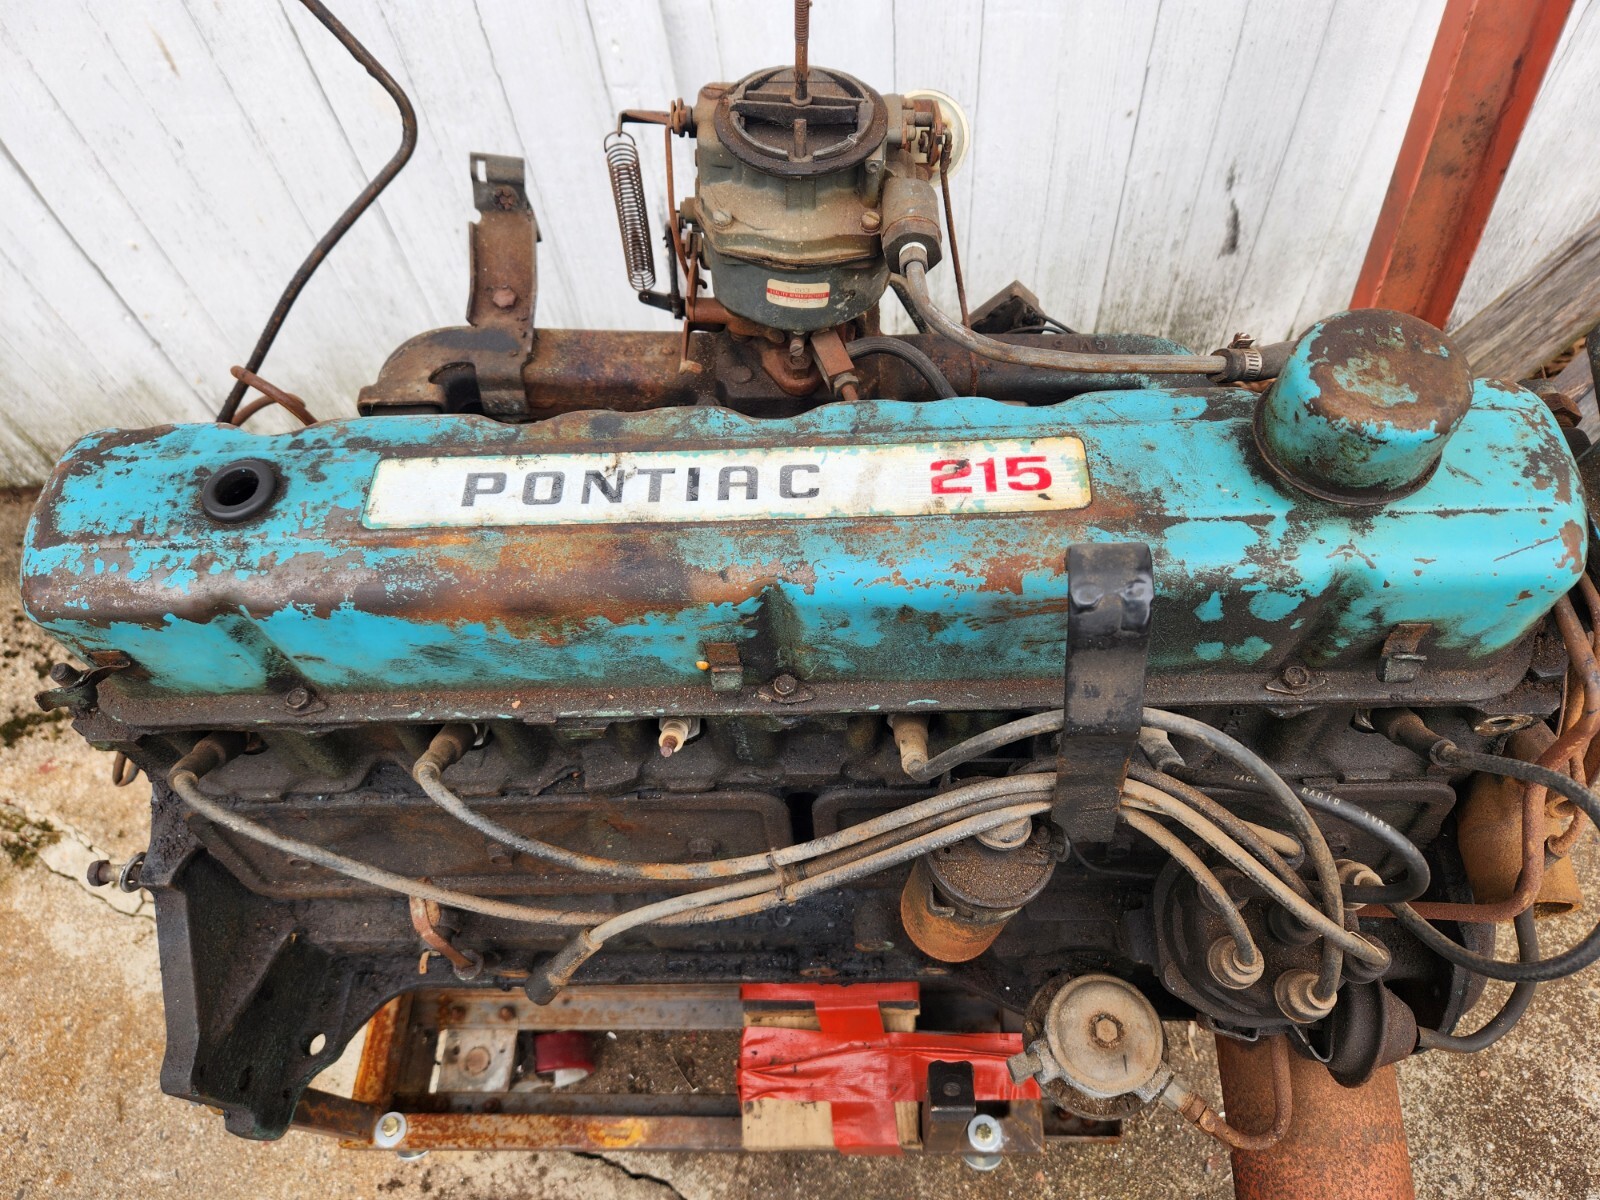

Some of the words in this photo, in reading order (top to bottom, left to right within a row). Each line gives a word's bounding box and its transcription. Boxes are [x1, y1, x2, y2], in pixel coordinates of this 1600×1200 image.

[461, 464, 820, 507] PONTIAC
[930, 456, 1053, 494] 215
[1301, 786, 1341, 807] RADIO
